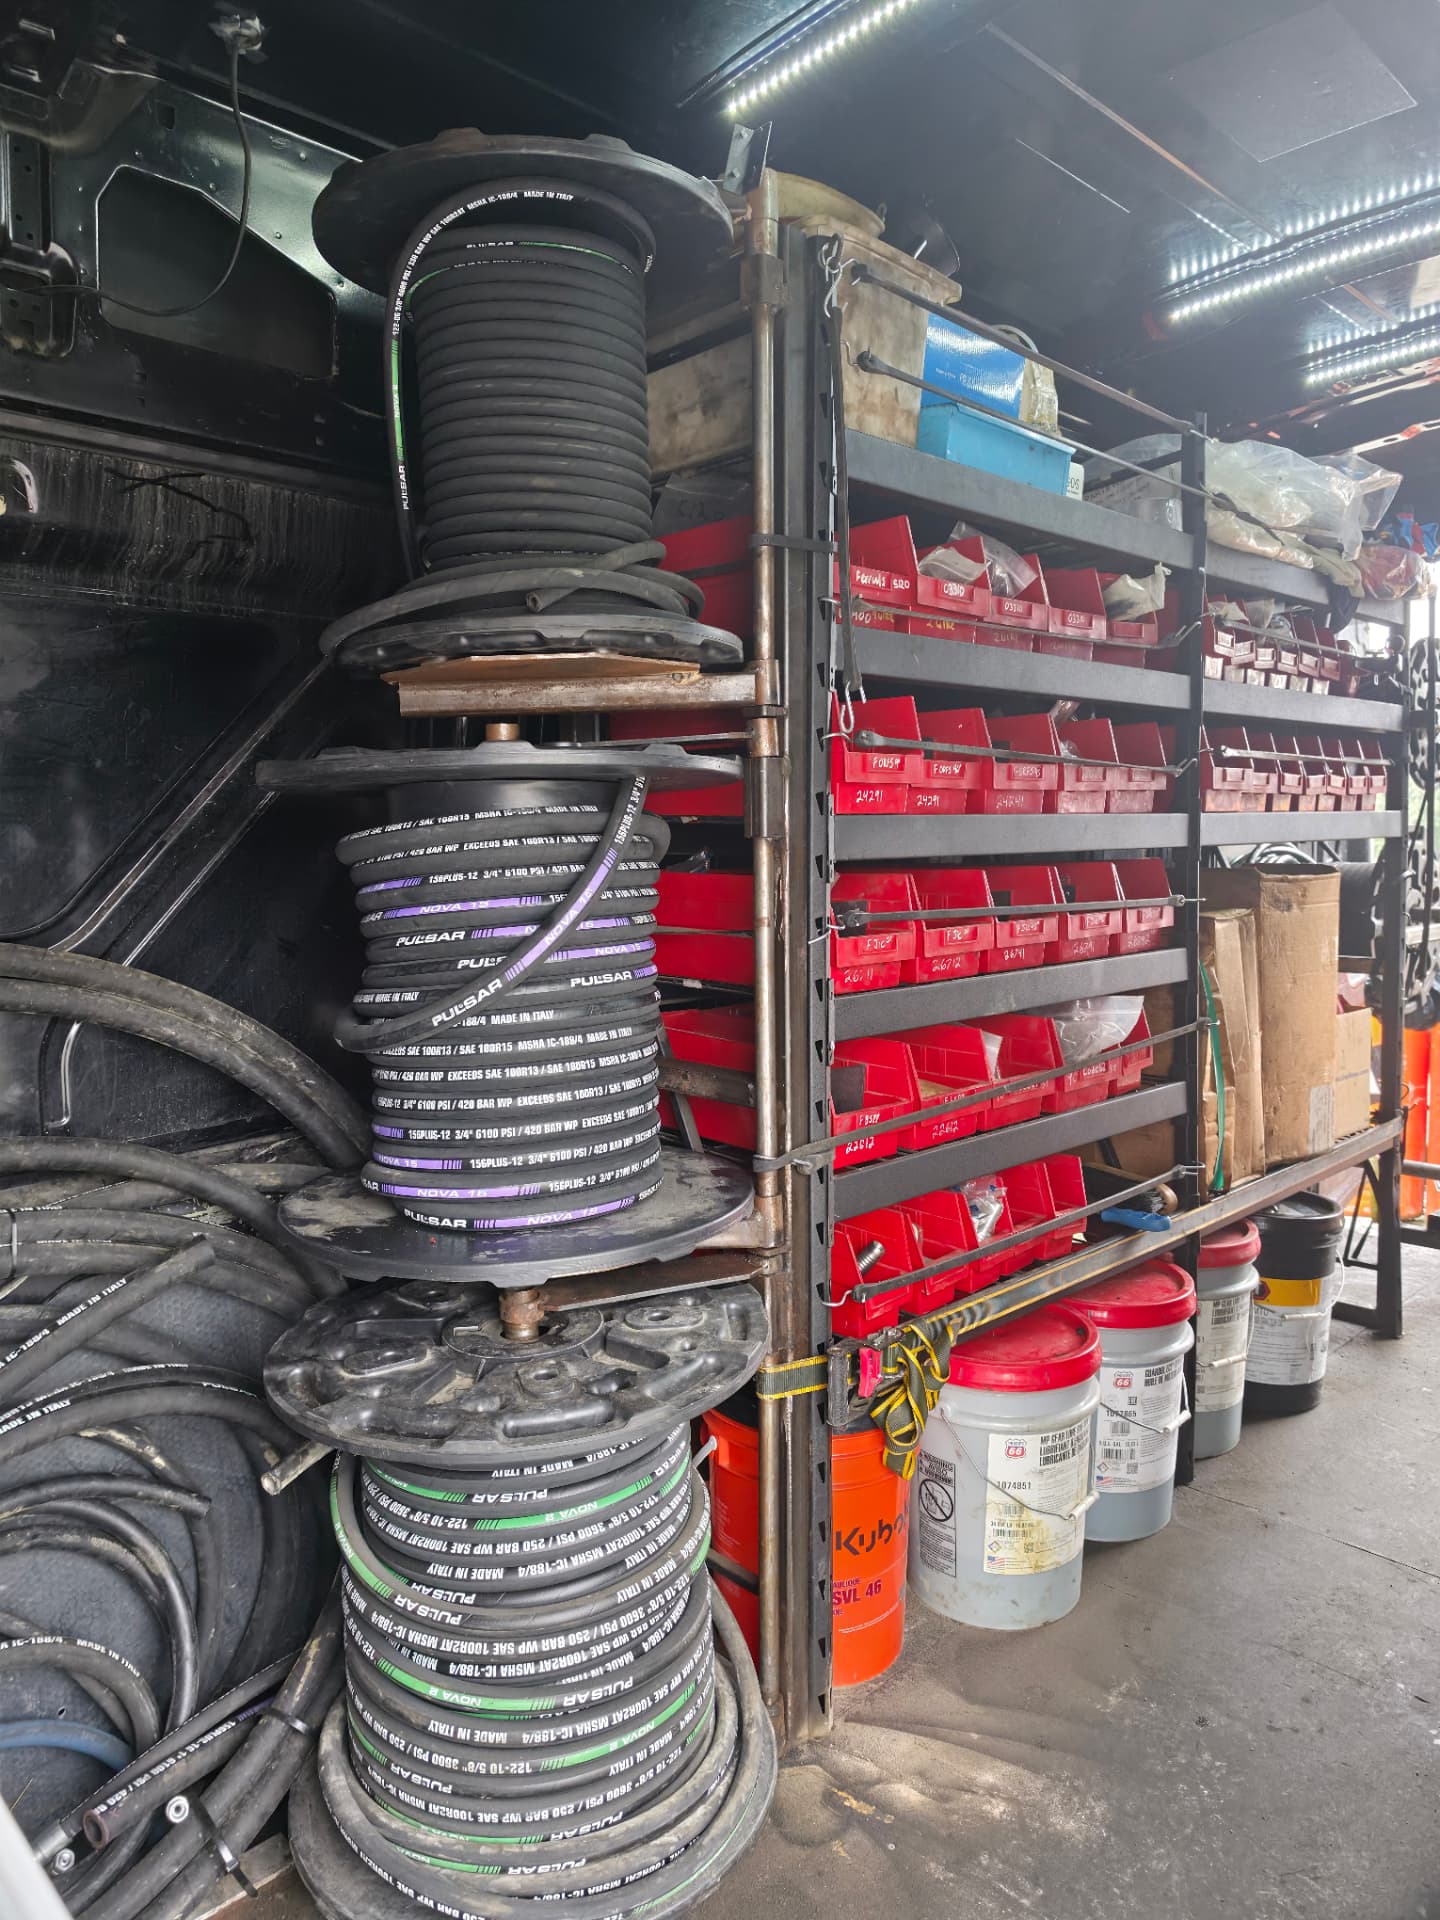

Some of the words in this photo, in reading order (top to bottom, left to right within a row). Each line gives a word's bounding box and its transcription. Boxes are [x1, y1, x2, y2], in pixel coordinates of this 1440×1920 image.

[523, 190, 544, 199] MADE
[546, 191, 556, 199] IN
[466, 197, 488, 211] MSHA
[430, 223, 442, 236] SAE
[414, 242, 427, 256] BAR
[393, 391, 401, 418] NOVA
[398, 465, 409, 510] PULSAR
[855, 789, 884, 804] 24291
[502, 836, 520, 847] SAE
[504, 867, 528, 877] 6100
[530, 866, 545, 875] PSI
[552, 864, 569, 874] 420
[419, 903, 462, 914] NOVA
[395, 930, 466, 947] PULSAR
[595, 944, 627, 955] NOVA
[431, 977, 503, 1027] PULSAR
[544, 909, 580, 946] NOVA
[570, 970, 633, 988] PULSAR
[490, 1012, 518, 1025] MADE
[519, 1011, 531, 1023] IN
[531, 1009, 555, 1022] ITALY
[422, 1045, 451, 1056] 100R13
[459, 1044, 476, 1055] SAE
[478, 1041, 513, 1053] 100R15
[517, 1039, 545, 1051] MSHA
[447, 1069, 483, 1081] EXCEEDS
[485, 1067, 502, 1079] SAE
[505, 1066, 539, 1078] 100R13
[546, 1064, 563, 1074] SAE
[566, 1060, 596, 1072] 100R15
[437, 1099, 451, 1111] PSI
[457, 1098, 474, 1110] 420
[476, 1098, 495, 1110] BAR
[497, 1097, 513, 1108] WP
[517, 1093, 555, 1107] EXCEEDS
[556, 1090, 573, 1103] SAE
[574, 1086, 603, 1100] 100R13
[455, 1128, 473, 1140] 3/4"
[475, 1128, 499, 1139] 6100
[500, 1127, 517, 1138] PSI
[523, 1124, 542, 1136] 420
[544, 1122, 562, 1134] BAR
[564, 1119, 579, 1132] WP
[582, 1112, 613, 1129] EXCEEDS
[528, 1152, 548, 1165] 3/4"
[550, 1149, 572, 1162] 6100
[573, 1147, 587, 1159] PSI
[593, 1143, 608, 1155] 420
[417, 1188, 460, 1198] NOVA
[403, 1208, 468, 1229] PULSAR
[527, 1212, 574, 1227] NOVA
[56, 1302, 88, 1327] MADE
[87, 1293, 102, 1306] IN
[101, 1277, 128, 1297] ITALY
[1115, 1379, 1131, 1388] 66
[26, 1409, 42, 1421] IN
[42, 1399, 72, 1415] ITALY
[1040, 1436, 1051, 1445] MP
[1008, 1447, 1023, 1456] 66
[471, 1487, 549, 1504] PULSAR
[388, 1502, 408, 1518] 3600
[559, 1500, 598, 1518] NOVA
[431, 1516, 469, 1531] 122-10
[577, 1521, 606, 1540] 3600
[406, 1532, 449, 1552] 100R2AT
[523, 1538, 546, 1552] 250
[556, 1531, 576, 1545] PSI
[604, 1522, 647, 1551] 100R2AT
[450, 1542, 473, 1556] SAE
[473, 1543, 493, 1556] WP
[495, 1542, 519, 1556] BAR
[569, 1548, 605, 1569] MSHA
[624, 1548, 648, 1570] ITALY
[426, 1562, 455, 1578] ITALY
[455, 1567, 469, 1579] IN
[471, 1567, 505, 1581] MADE
[517, 1557, 569, 1579] IC-188/4
[654, 1558, 678, 1580] MADE
[410, 1582, 477, 1606] PULSAR
[615, 1584, 642, 1605] ITALY
[832, 1587, 861, 1606] SVL
[865, 1578, 883, 1597] 46
[393, 1593, 464, 1627] PULSAR
[618, 1605, 647, 1628] 3600
[370, 1610, 408, 1644] IC-188/4
[600, 1619, 619, 1637] PSI
[407, 1629, 440, 1651] MSHA
[541, 1635, 566, 1652] BAR
[568, 1629, 591, 1647] 250
[76, 1638, 107, 1654] MADE
[108, 1649, 120, 1661] IN
[439, 1640, 489, 1657] 100R2AT
[492, 1642, 515, 1657] SAE
[518, 1640, 539, 1656] WP
[589, 1641, 611, 1659] SAE
[411, 1650, 439, 1672] MADE
[449, 1661, 498, 1678] IC-188/4
[500, 1660, 536, 1678] MSHA
[539, 1649, 589, 1674] 100R2AT
[442, 1688, 483, 1708] NOVA
[562, 1675, 634, 1708] PULSAR
[610, 1699, 654, 1726] 100R2AT
[427, 1718, 456, 1737] ITALY
[456, 1726, 471, 1741] IN
[575, 1717, 610, 1738] MSHA
[622, 1720, 657, 1747] NOVA
[473, 1729, 508, 1746] MADE
[522, 1728, 574, 1746] IC-188/4
[648, 1730, 673, 1753] MADE
[412, 1746, 431, 1764] PSI
[430, 1753, 460, 1771] 3600
[150, 1756, 177, 1777] 6100
[461, 1760, 488, 1776] 5/8"
[489, 1761, 534, 1776] 122-10
[608, 1756, 635, 1777] ITALY
[131, 1772, 152, 1789] PSI
[389, 1761, 454, 1795] PULSAR
[107, 1788, 129, 1807] 420
[605, 1780, 634, 1799] 3600
[428, 1803, 475, 1822] 100R2AT
[478, 1811, 500, 1824] SAE
[501, 1812, 523, 1824] WP
[552, 1804, 575, 1819] 250
[550, 1810, 624, 1842] PULSAR
[507, 1856, 587, 1875] PULSAR
